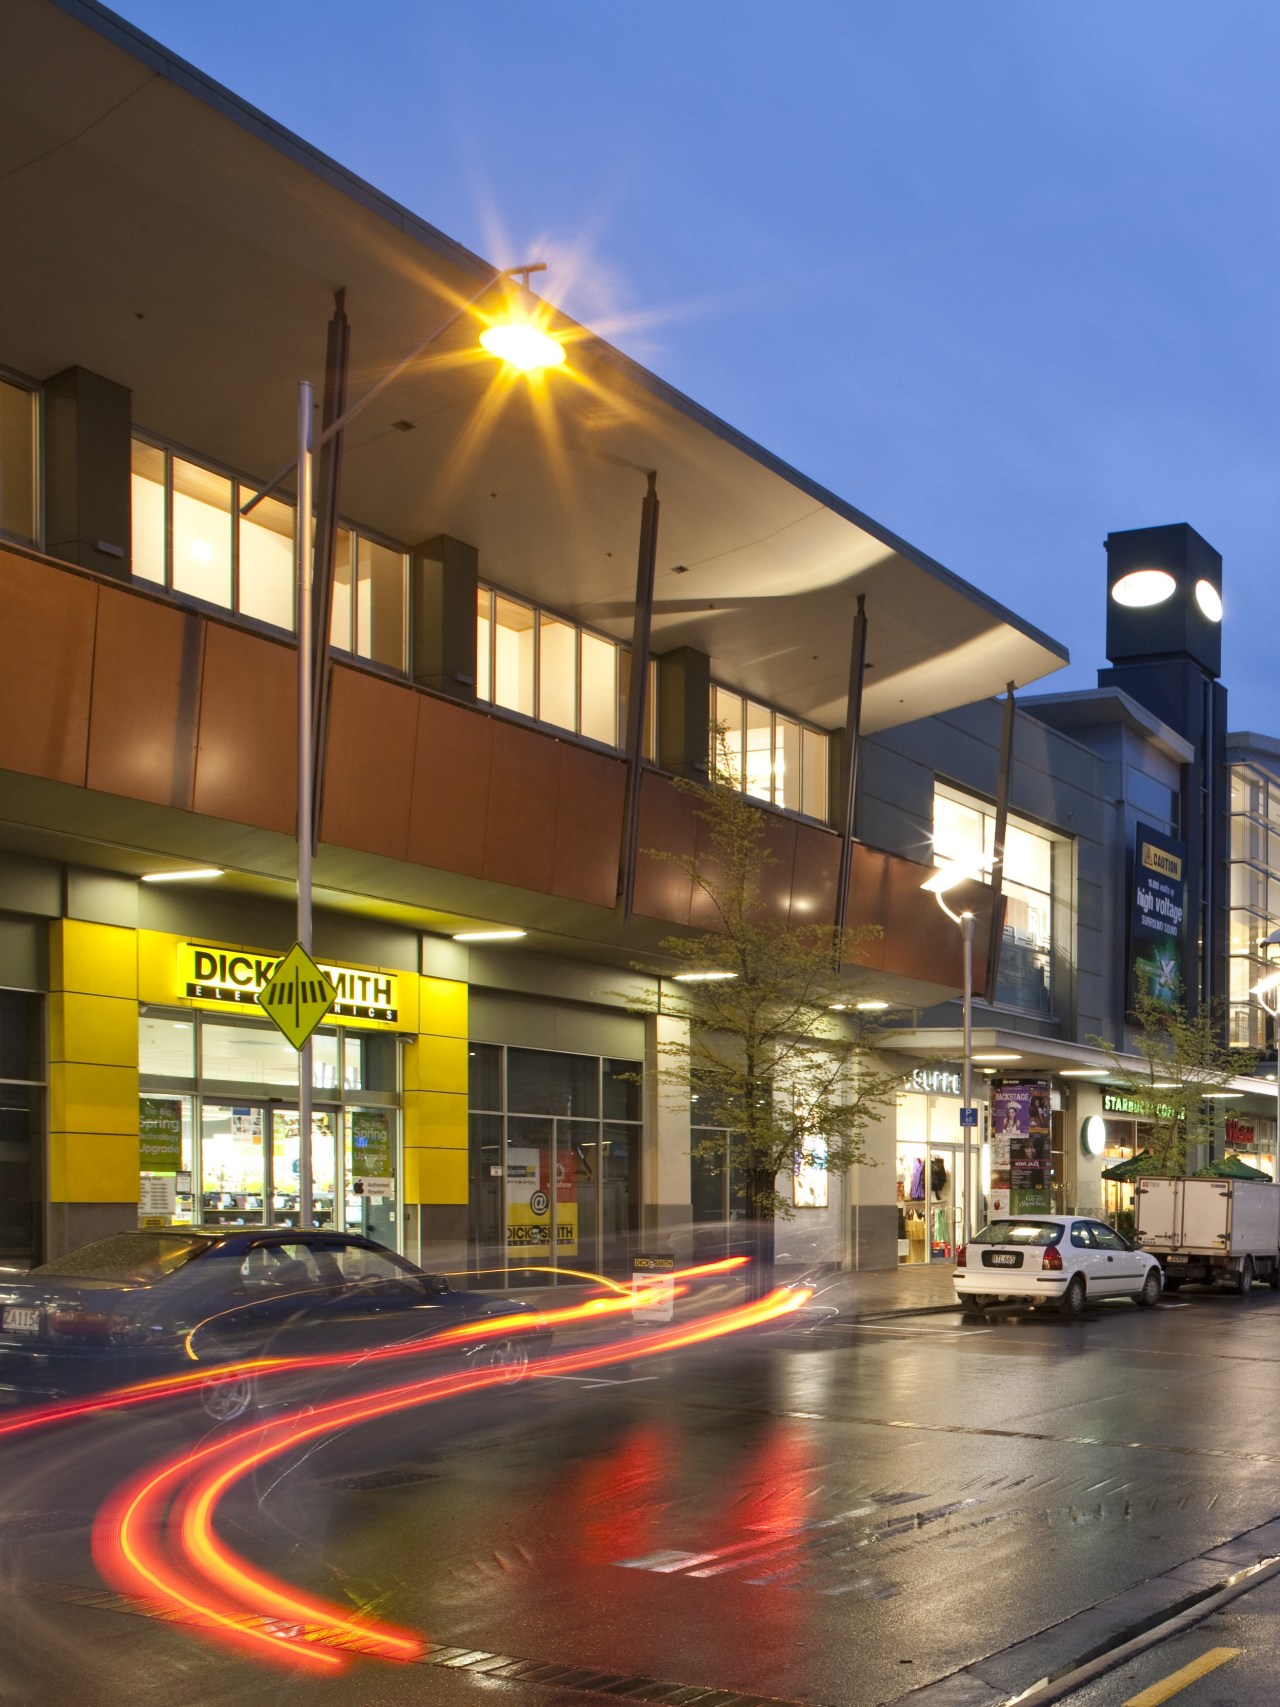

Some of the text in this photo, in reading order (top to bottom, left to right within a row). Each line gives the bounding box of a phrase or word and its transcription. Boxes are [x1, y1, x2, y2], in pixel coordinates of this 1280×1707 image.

[1153, 853, 1178, 876] CAUTION
[1137, 887, 1183, 924] high voltage
[1141, 914, 1178, 936] SURROUND SOUND
[194, 950, 274, 988] DICK
[995, 1092, 1030, 1101] BACKSTAGE
[965, 1109, 972, 1117] P
[139, 1114, 180, 1133] Spring
[354, 1126, 388, 1143] Spring
[354, 1150, 388, 1162] Upgrade
